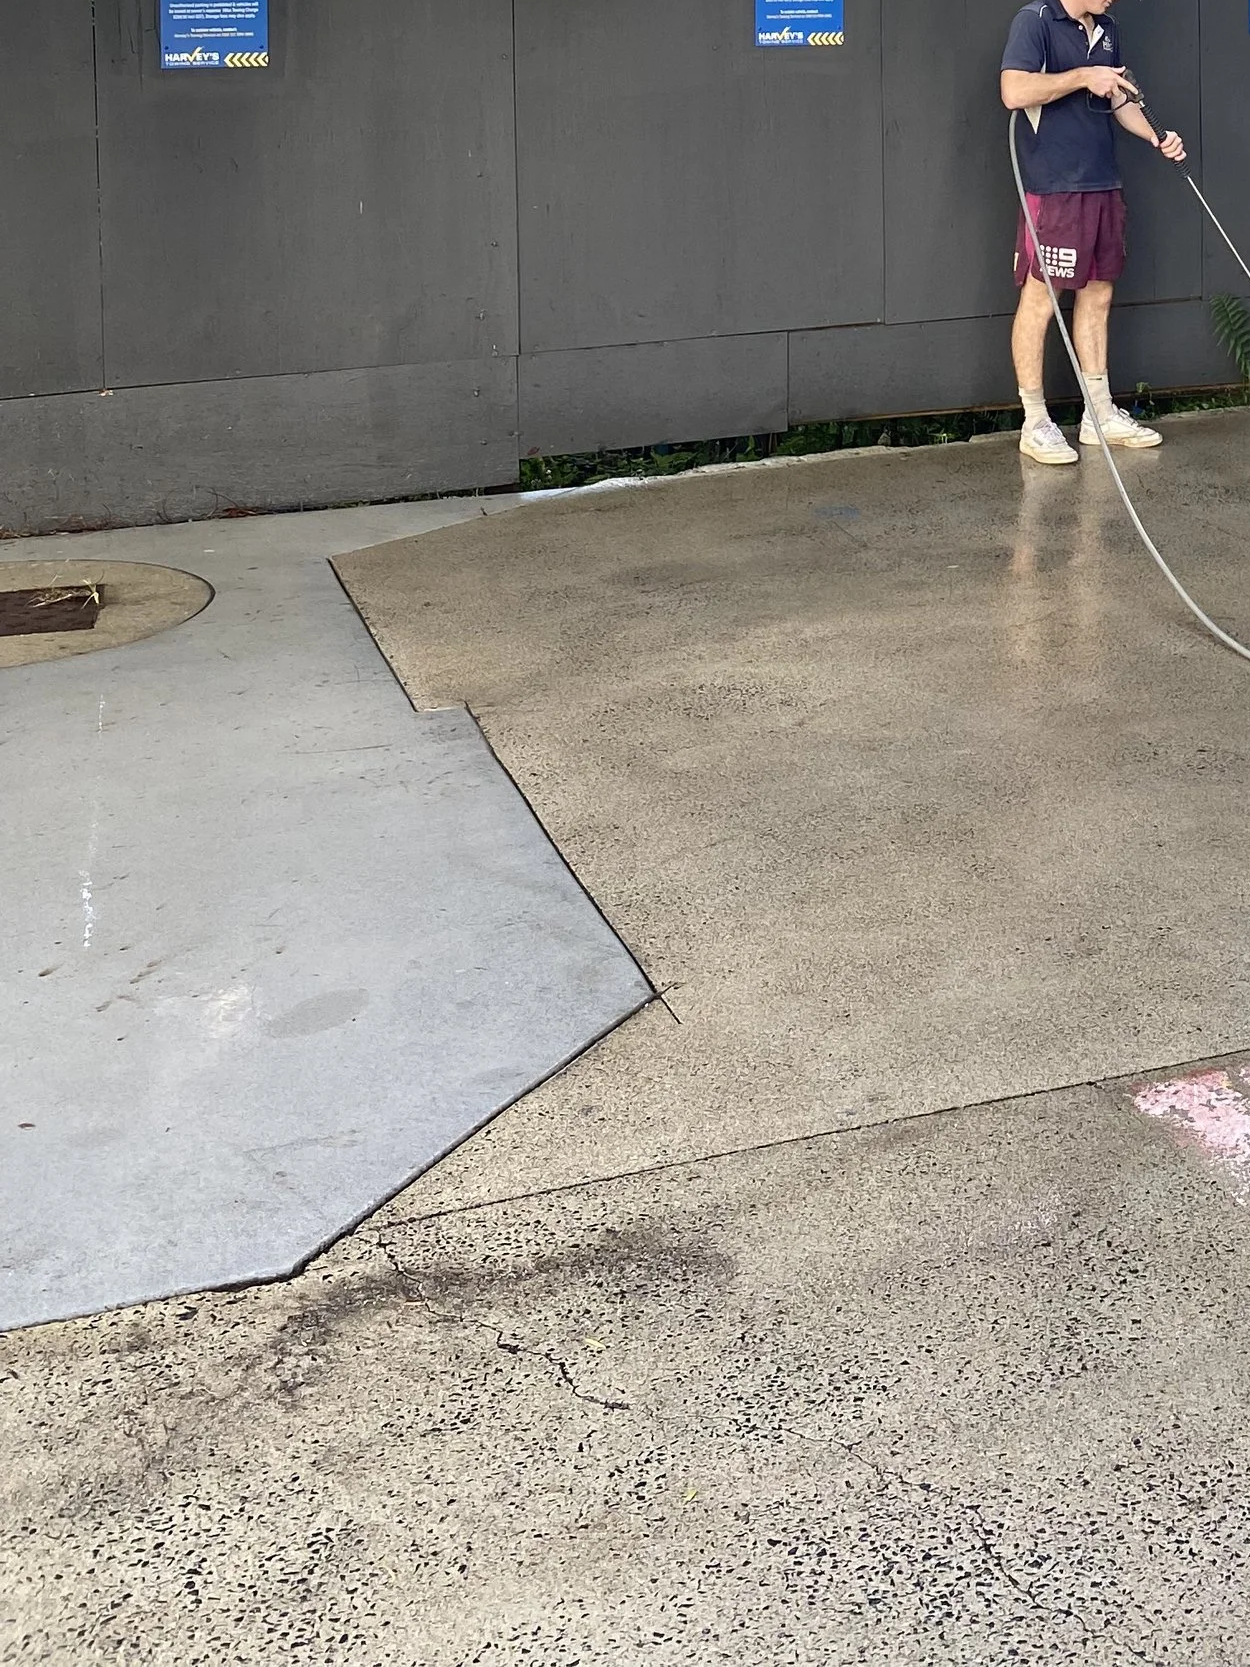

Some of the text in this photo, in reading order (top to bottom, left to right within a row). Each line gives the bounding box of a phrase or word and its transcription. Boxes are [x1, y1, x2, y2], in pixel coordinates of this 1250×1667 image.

[164, 46, 220, 62] HARVEY'S
[1058, 247, 1077, 268] 9
[1040, 264, 1075, 278] EWS
